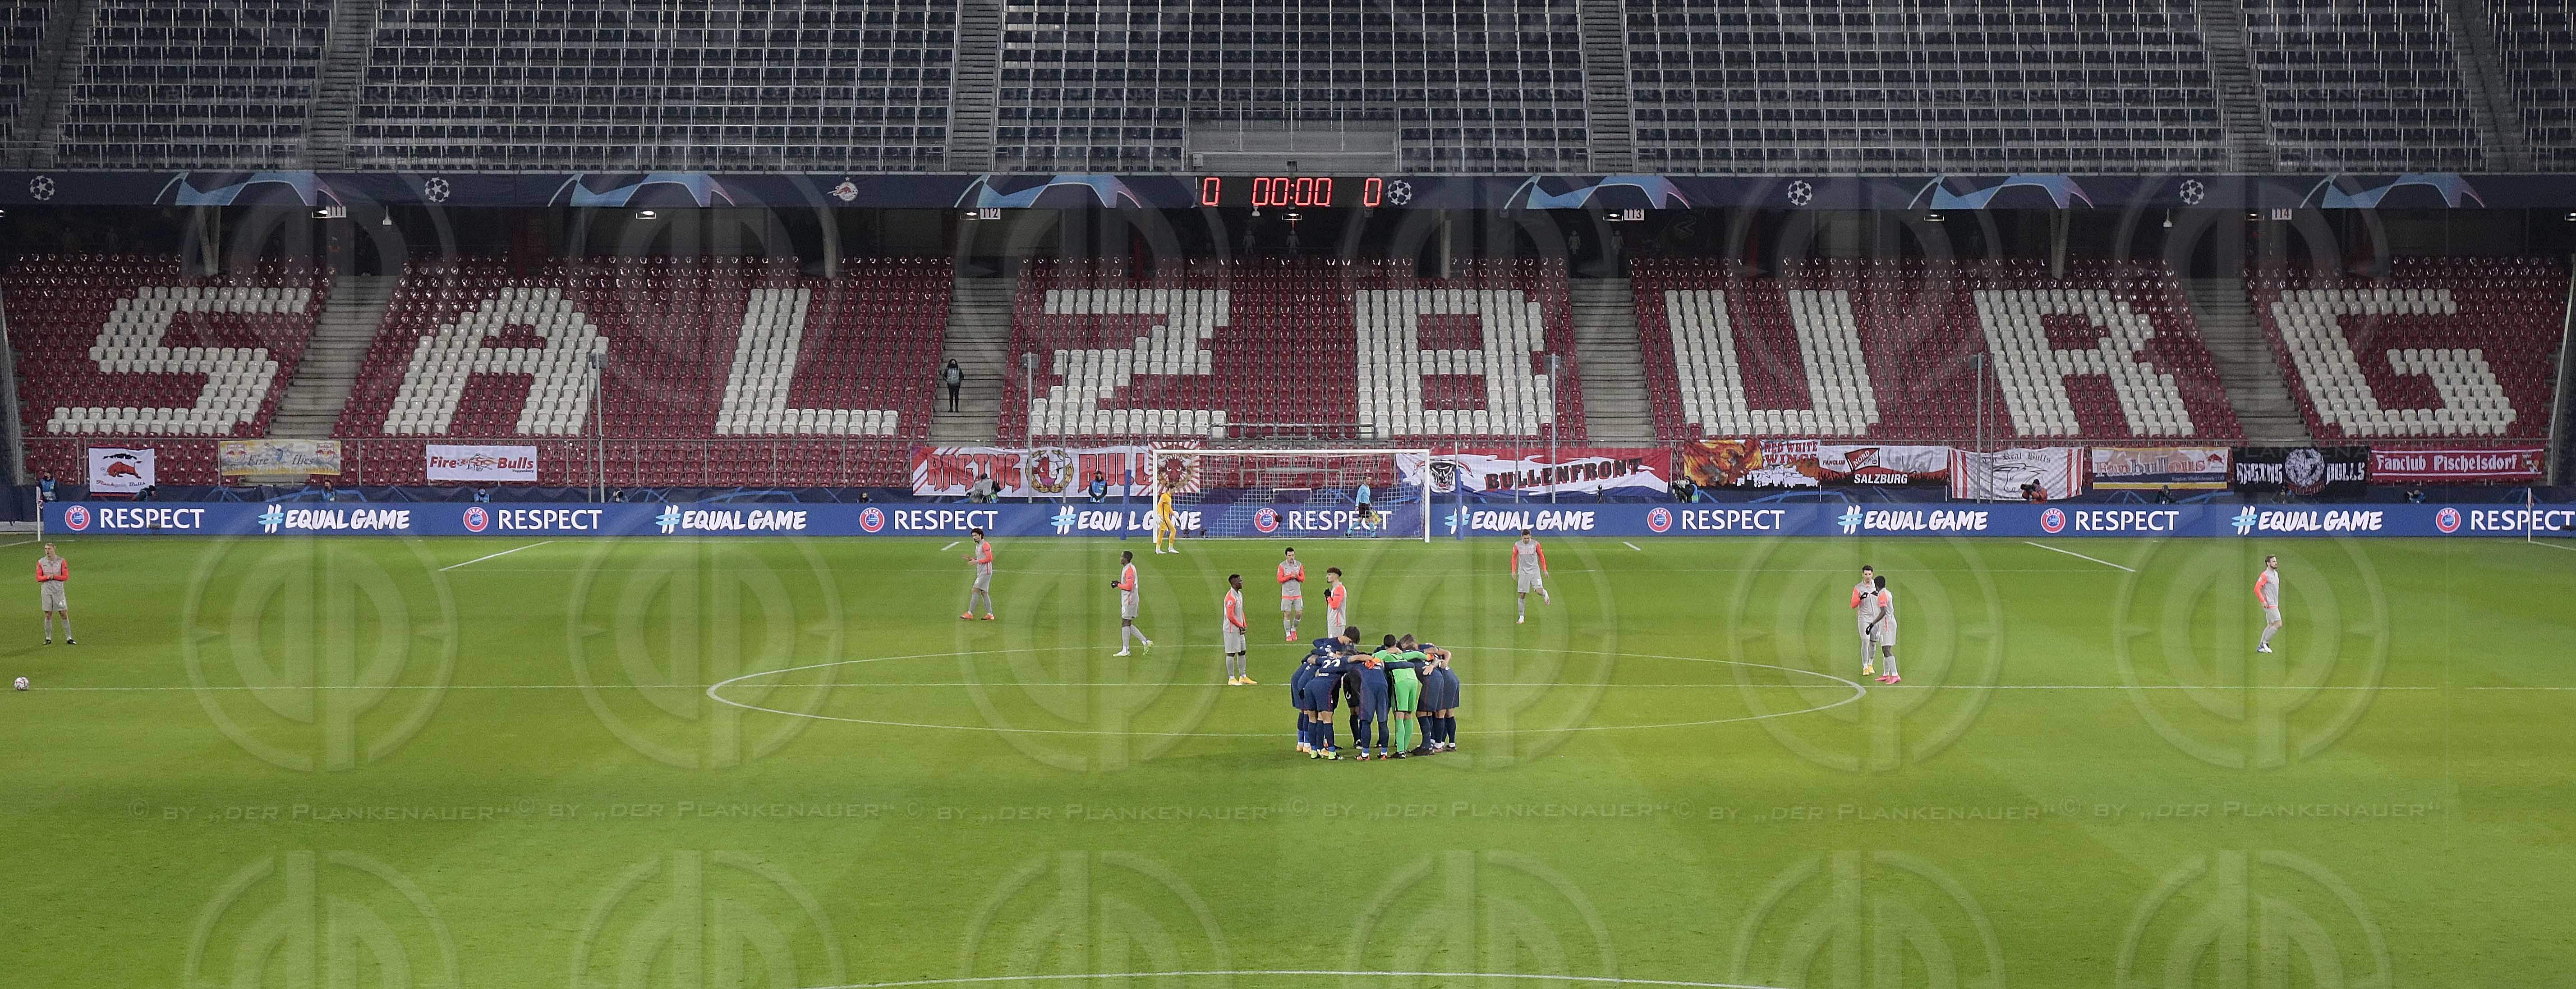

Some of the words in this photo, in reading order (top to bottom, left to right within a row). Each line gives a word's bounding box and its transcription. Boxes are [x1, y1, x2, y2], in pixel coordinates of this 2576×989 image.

[1202, 177, 1221, 206] 0
[1252, 177, 1332, 206] 00:00
[1363, 178, 1382, 206] 0
[983, 208, 998, 218] 112
[1627, 209, 1642, 219] 113
[2275, 208, 2289, 218] 114
[1787, 441, 1818, 453] WHITE
[429, 456, 456, 468] Fire
[497, 457, 534, 469] Bulls
[1765, 453, 1818, 464] WINGS
[1853, 450, 1870, 467] NORD
[2003, 452, 2022, 460] Real
[2028, 452, 2051, 462] Bulls
[2376, 454, 2426, 471] Fanclub
[1485, 457, 1643, 491] BULLENFRONT
[1854, 474, 1908, 485] SALZBURG
[101, 508, 204, 528] RESPECT
[498, 510, 602, 529] RESPECT
[895, 510, 998, 529] RESPECT
[1682, 510, 1785, 529] RESPECT
[2076, 511, 2179, 530] RESPECT
[2471, 510, 2575, 530] RESPECT
